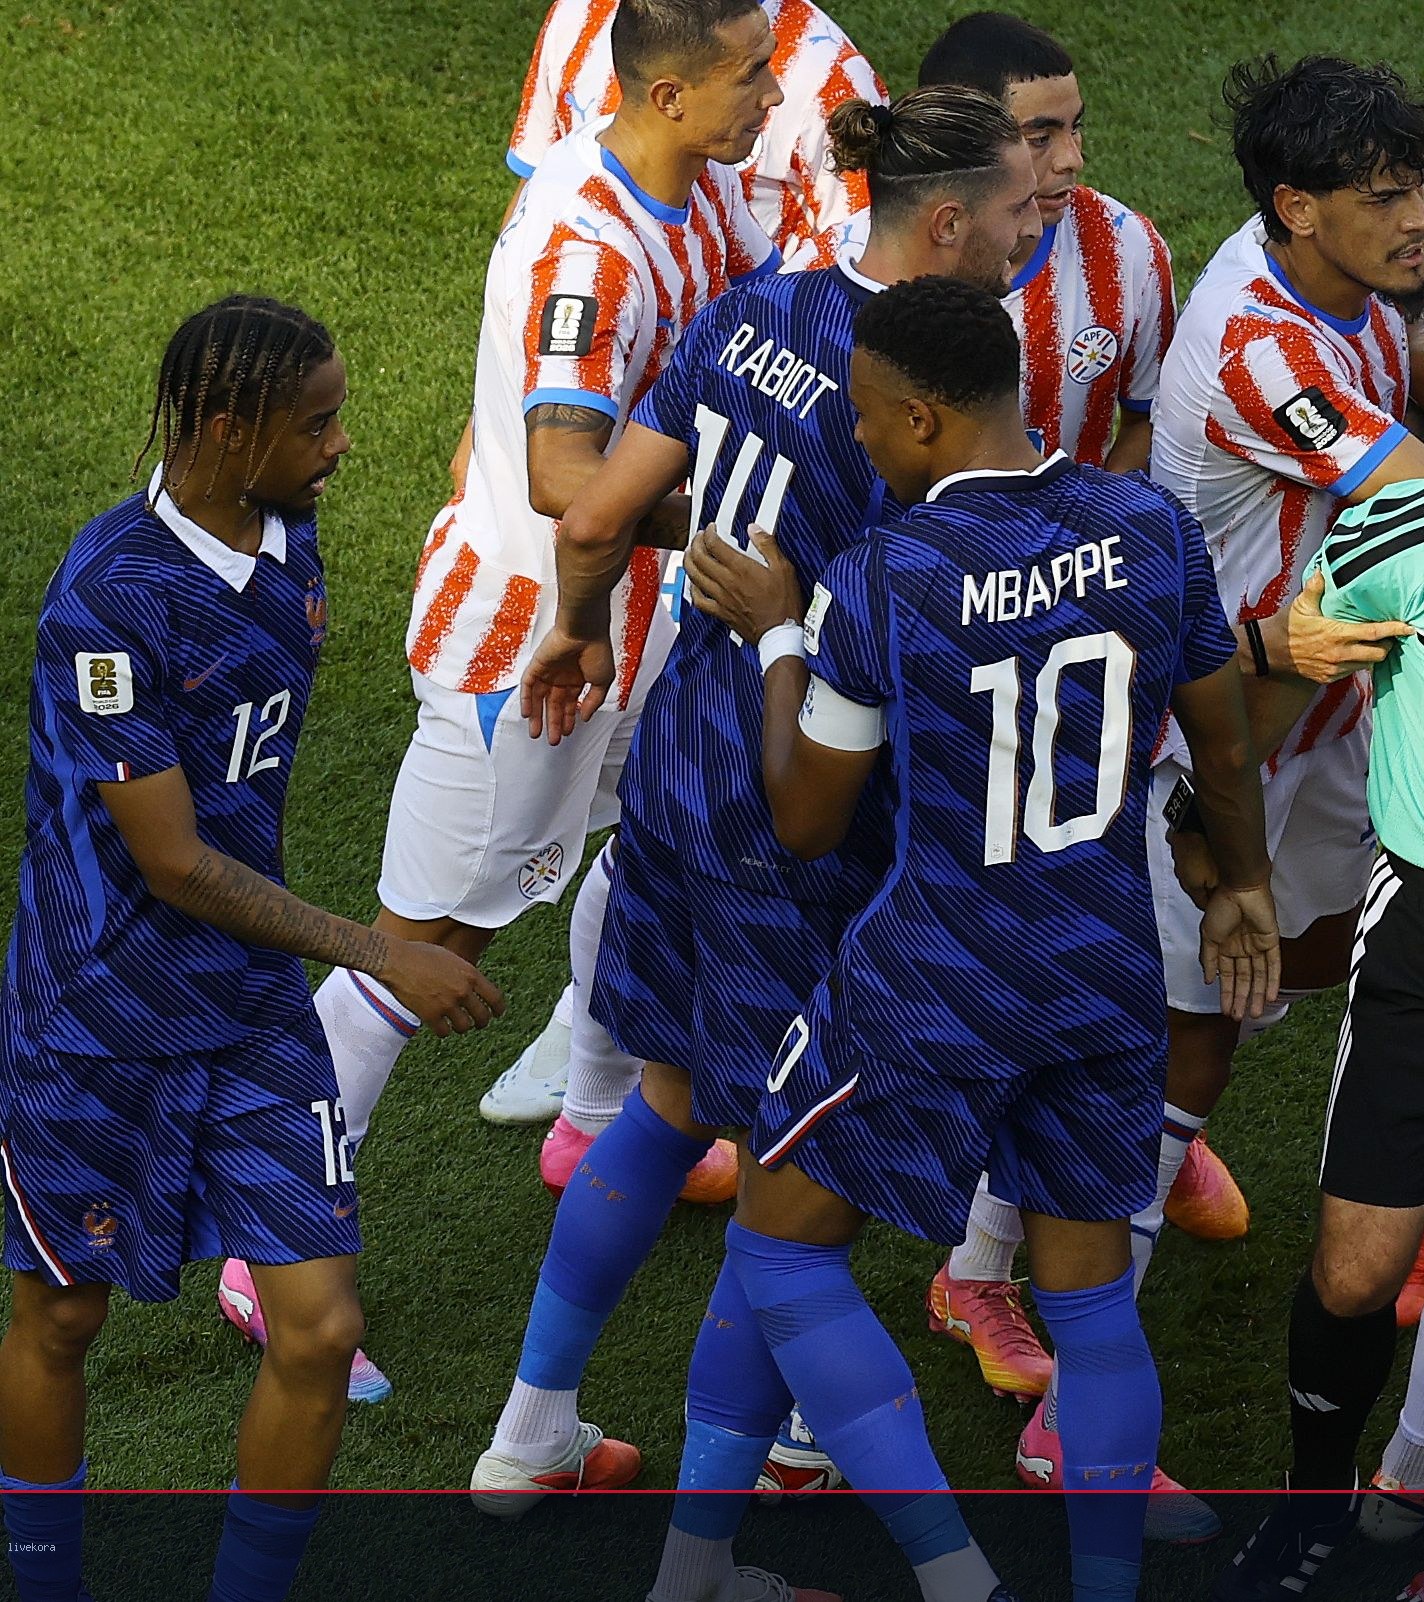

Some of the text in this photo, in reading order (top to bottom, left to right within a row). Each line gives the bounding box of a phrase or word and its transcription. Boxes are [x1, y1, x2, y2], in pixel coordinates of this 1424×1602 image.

[717, 322, 839, 420] RABIOT
[1083, 330, 1102, 343] APF
[961, 535, 1129, 626] MBAPPE
[225, 688, 292, 784] 12
[969, 630, 1138, 867] 10
[311, 1097, 355, 1186] 12
